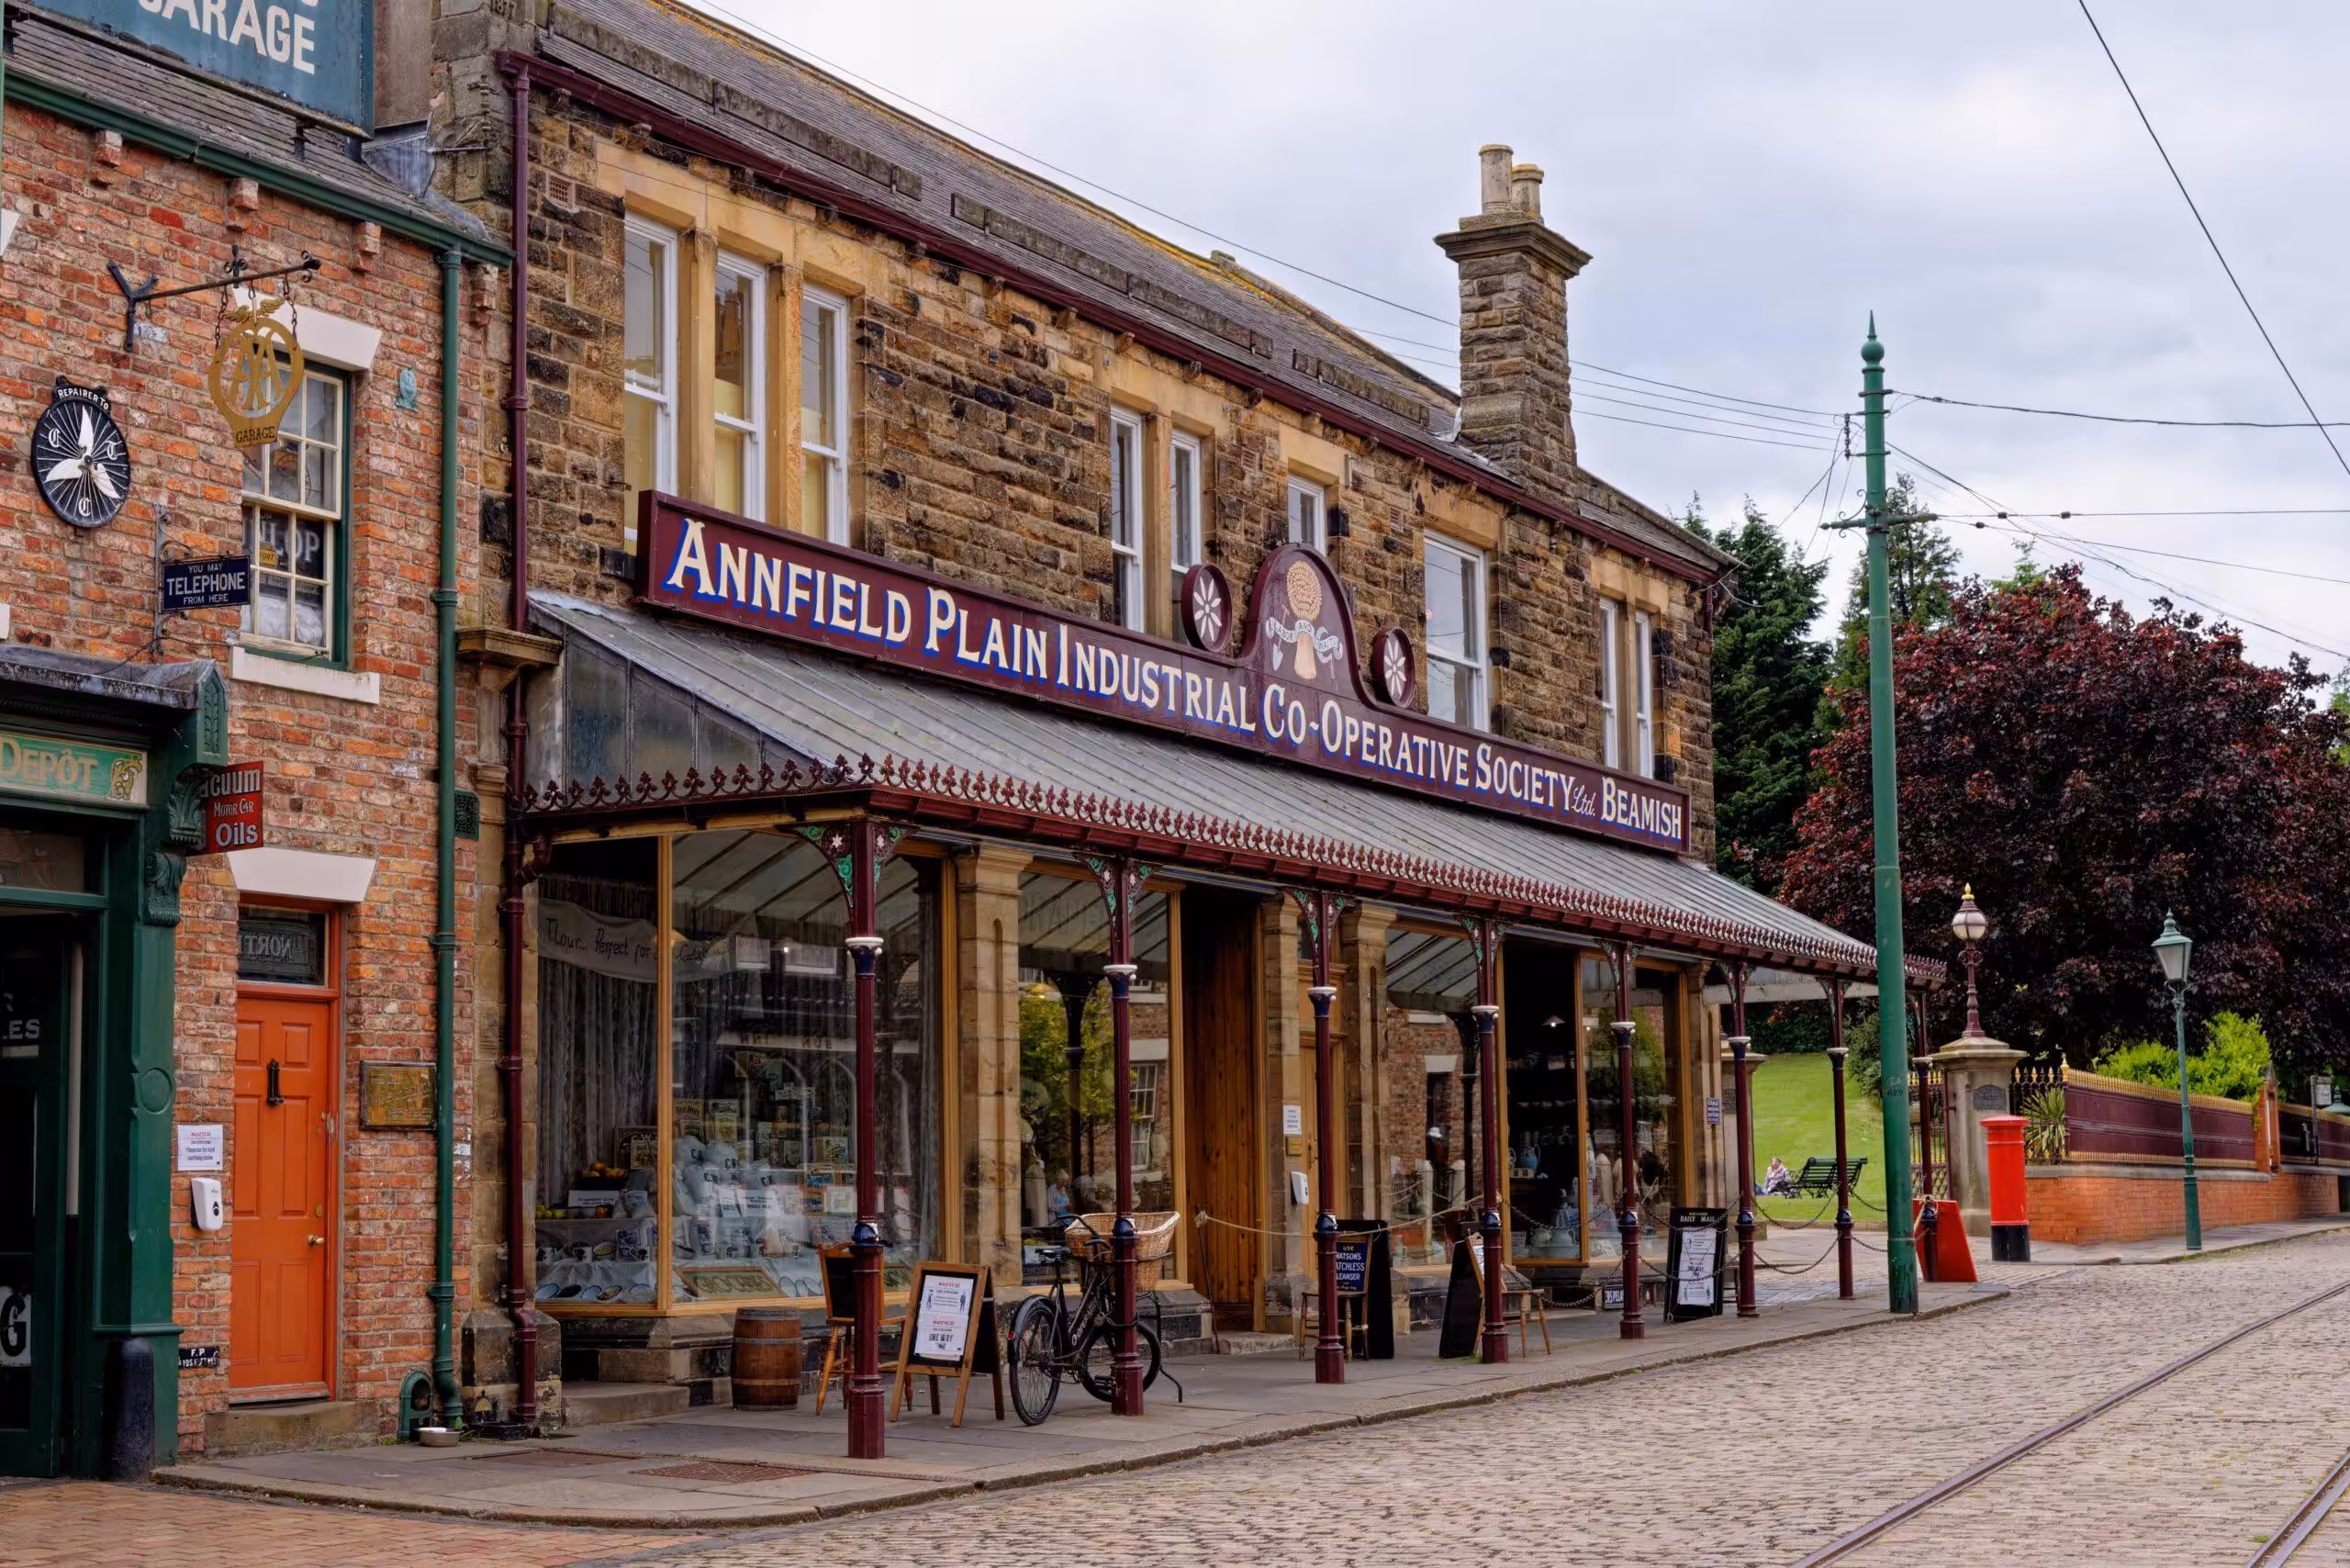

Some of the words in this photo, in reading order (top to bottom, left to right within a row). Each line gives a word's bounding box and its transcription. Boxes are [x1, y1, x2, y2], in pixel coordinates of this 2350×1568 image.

[140, 0, 315, 75] ARAGE
[57, 388, 97, 405] REPAIRER
[99, 398, 109, 410] TO
[235, 426, 275, 443] GARAGE
[188, 565, 204, 574] YOU
[207, 563, 224, 572] MAY
[166, 571, 246, 596] TELEPHONE
[184, 596, 205, 606] FROM
[208, 593, 229, 603] HERE
[1273, 622, 1293, 642] LABOR
[1298, 622, 1312, 633] AND
[665, 518, 912, 644] ANNFIELD
[924, 586, 1048, 680] PLAIN
[1056, 623, 1257, 733] INDUSTRIAL
[1474, 743, 1577, 812] SOCIETY
[1572, 784, 1596, 817] Ltd.
[1600, 776, 1683, 841] BEAMISH
[214, 802, 239, 818] MOTOR
[240, 798, 255, 814] CAR
[216, 821, 259, 847] Oils
[1680, 1215, 1695, 1223] DAILY
[1337, 1272, 1360, 1281] LEANSER
[940, 1334, 954, 1342] WAY
